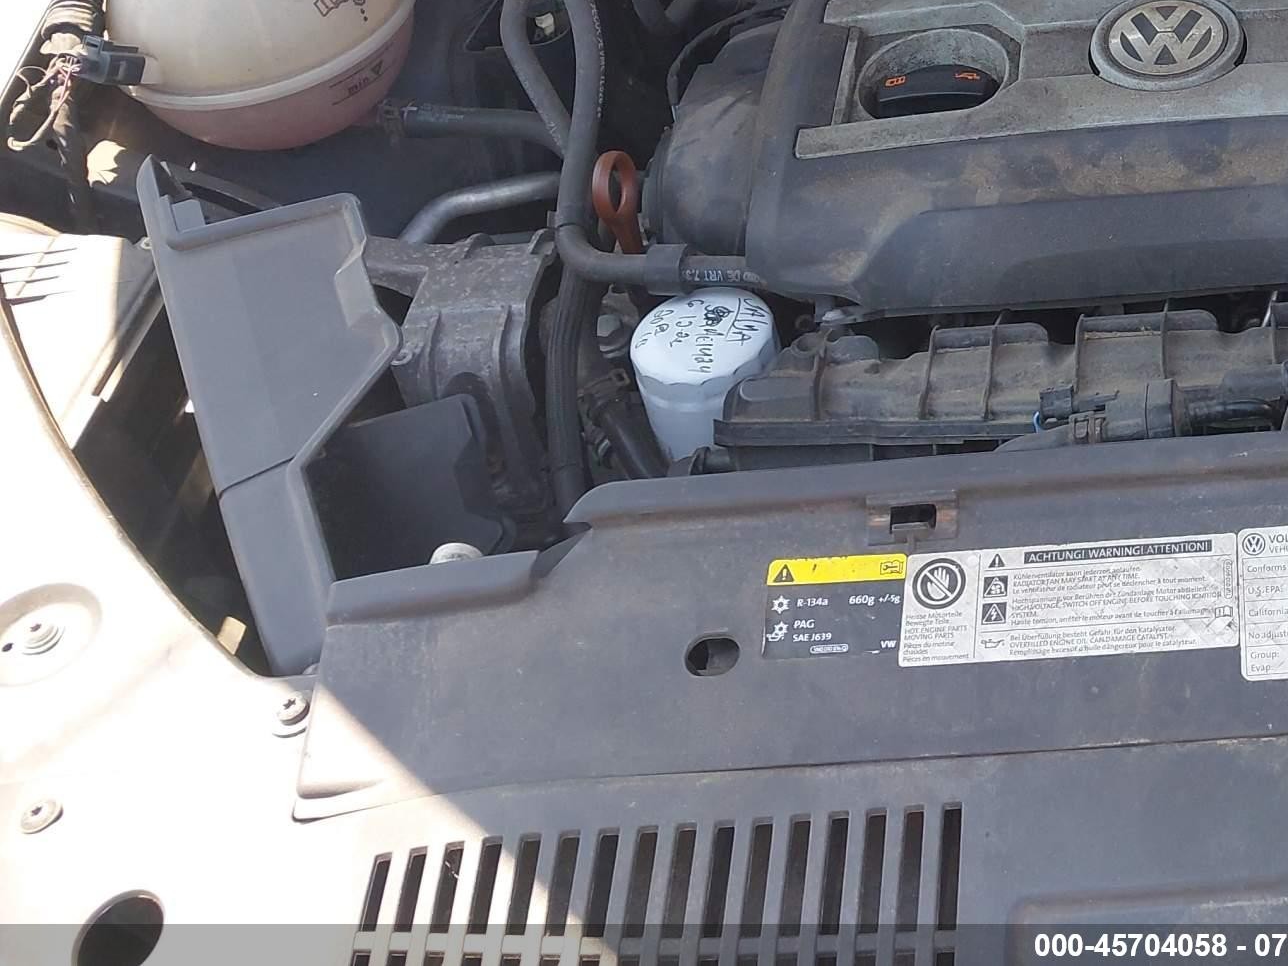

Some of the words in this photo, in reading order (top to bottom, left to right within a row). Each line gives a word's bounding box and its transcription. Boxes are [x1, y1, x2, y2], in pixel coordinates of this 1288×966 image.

[1028, 550, 1085, 563] ACHTUNG!
[1088, 546, 1144, 558] WARNING!
[1146, 541, 1208, 554] ATTENTION!
[1247, 562, 1286, 573] Conforms
[796, 597, 829, 607] R-134a
[849, 594, 875, 606] 660g
[878, 594, 900, 605] +/-5g
[793, 619, 815, 629] PAG
[792, 633, 810, 642] SAE
[810, 632, 832, 642] J639
[1248, 630, 1260, 639] No
[880, 640, 897, 648] VW
[1250, 651, 1280, 660] Group:
